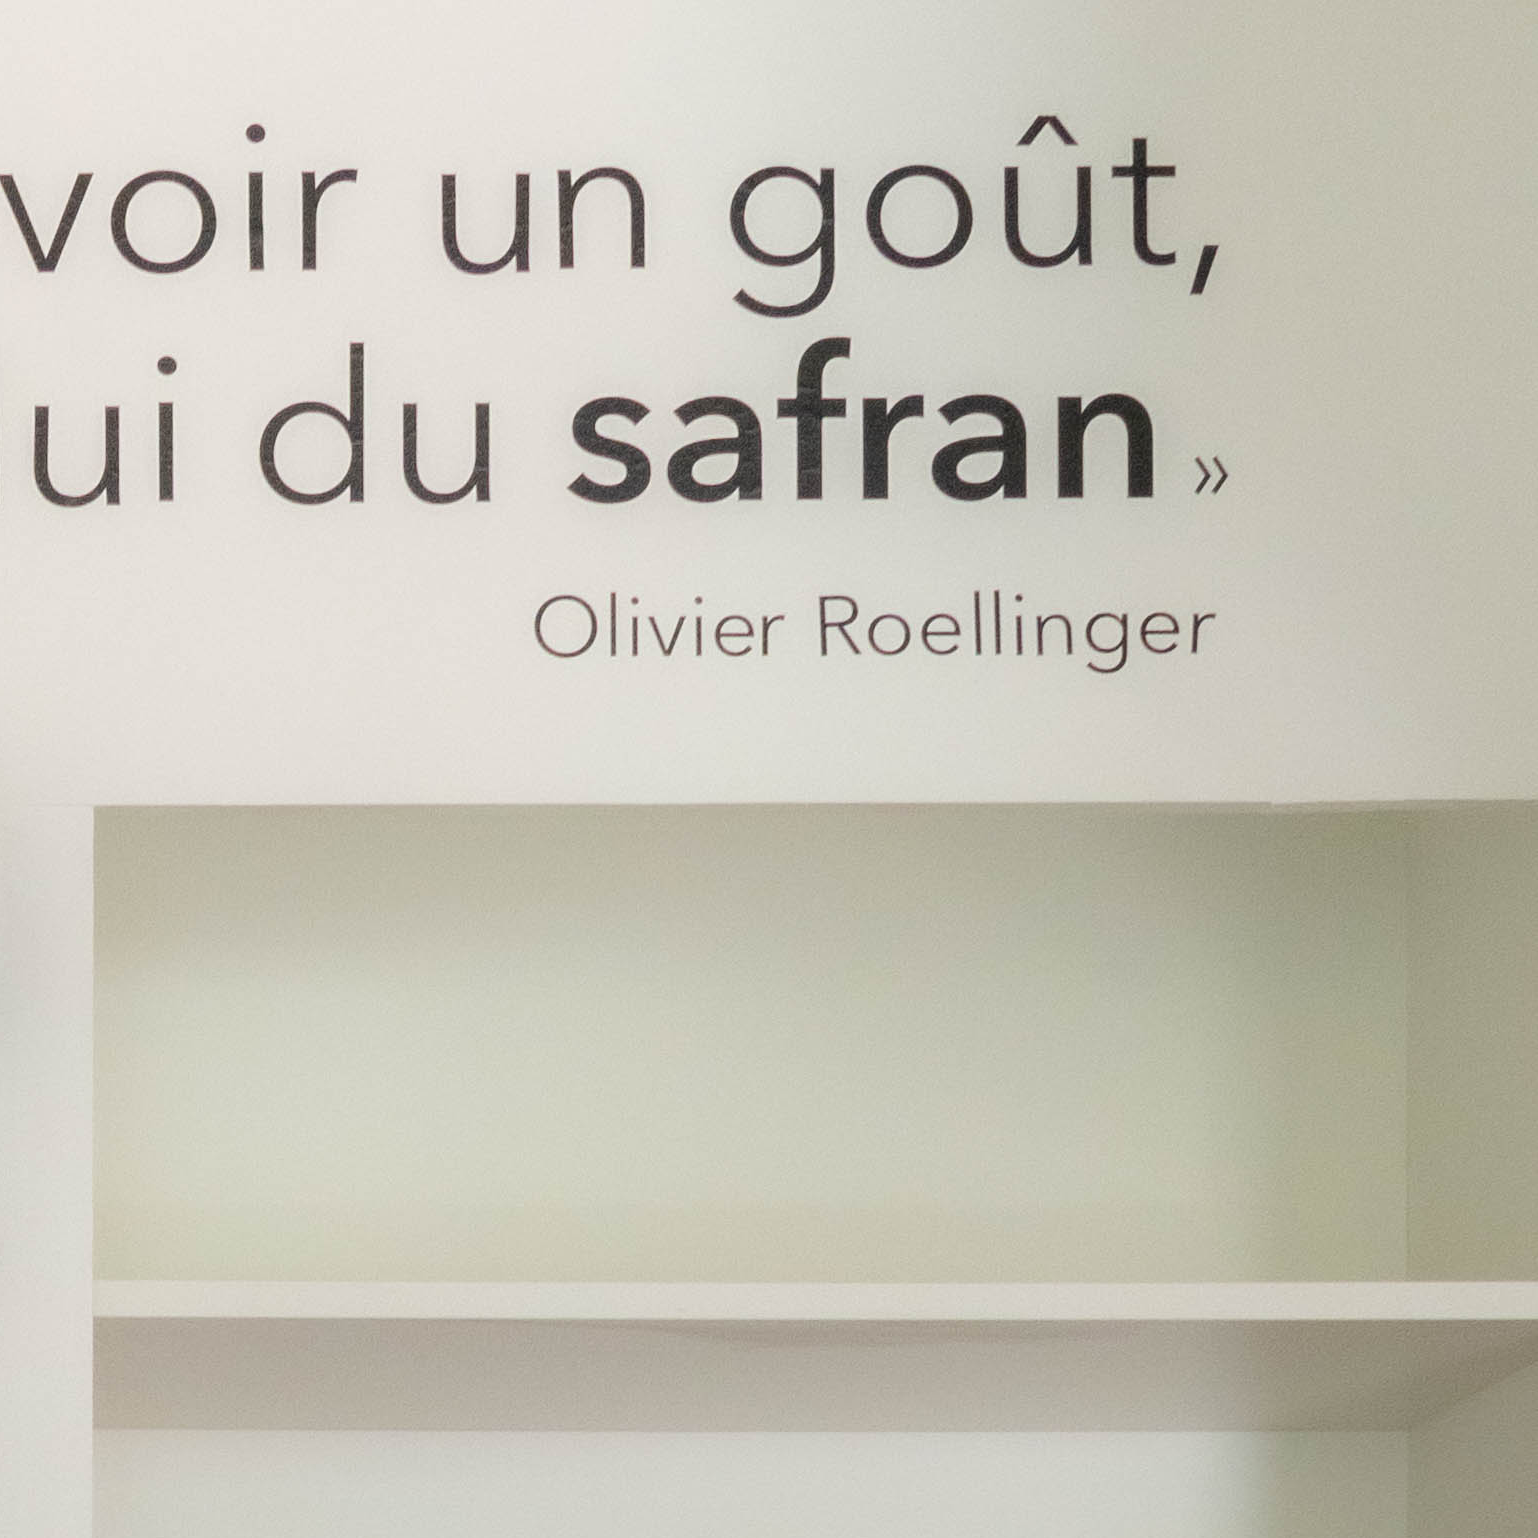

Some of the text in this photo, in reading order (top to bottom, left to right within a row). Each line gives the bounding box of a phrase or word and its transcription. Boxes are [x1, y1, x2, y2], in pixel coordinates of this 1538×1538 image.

[441, 167, 647, 276] un
[731, 115, 1221, 319] goût,
[259, 343, 492, 507] du
[567, 340, 1155, 505] safran
[535, 589, 1218, 676] Olivier Roellinger
